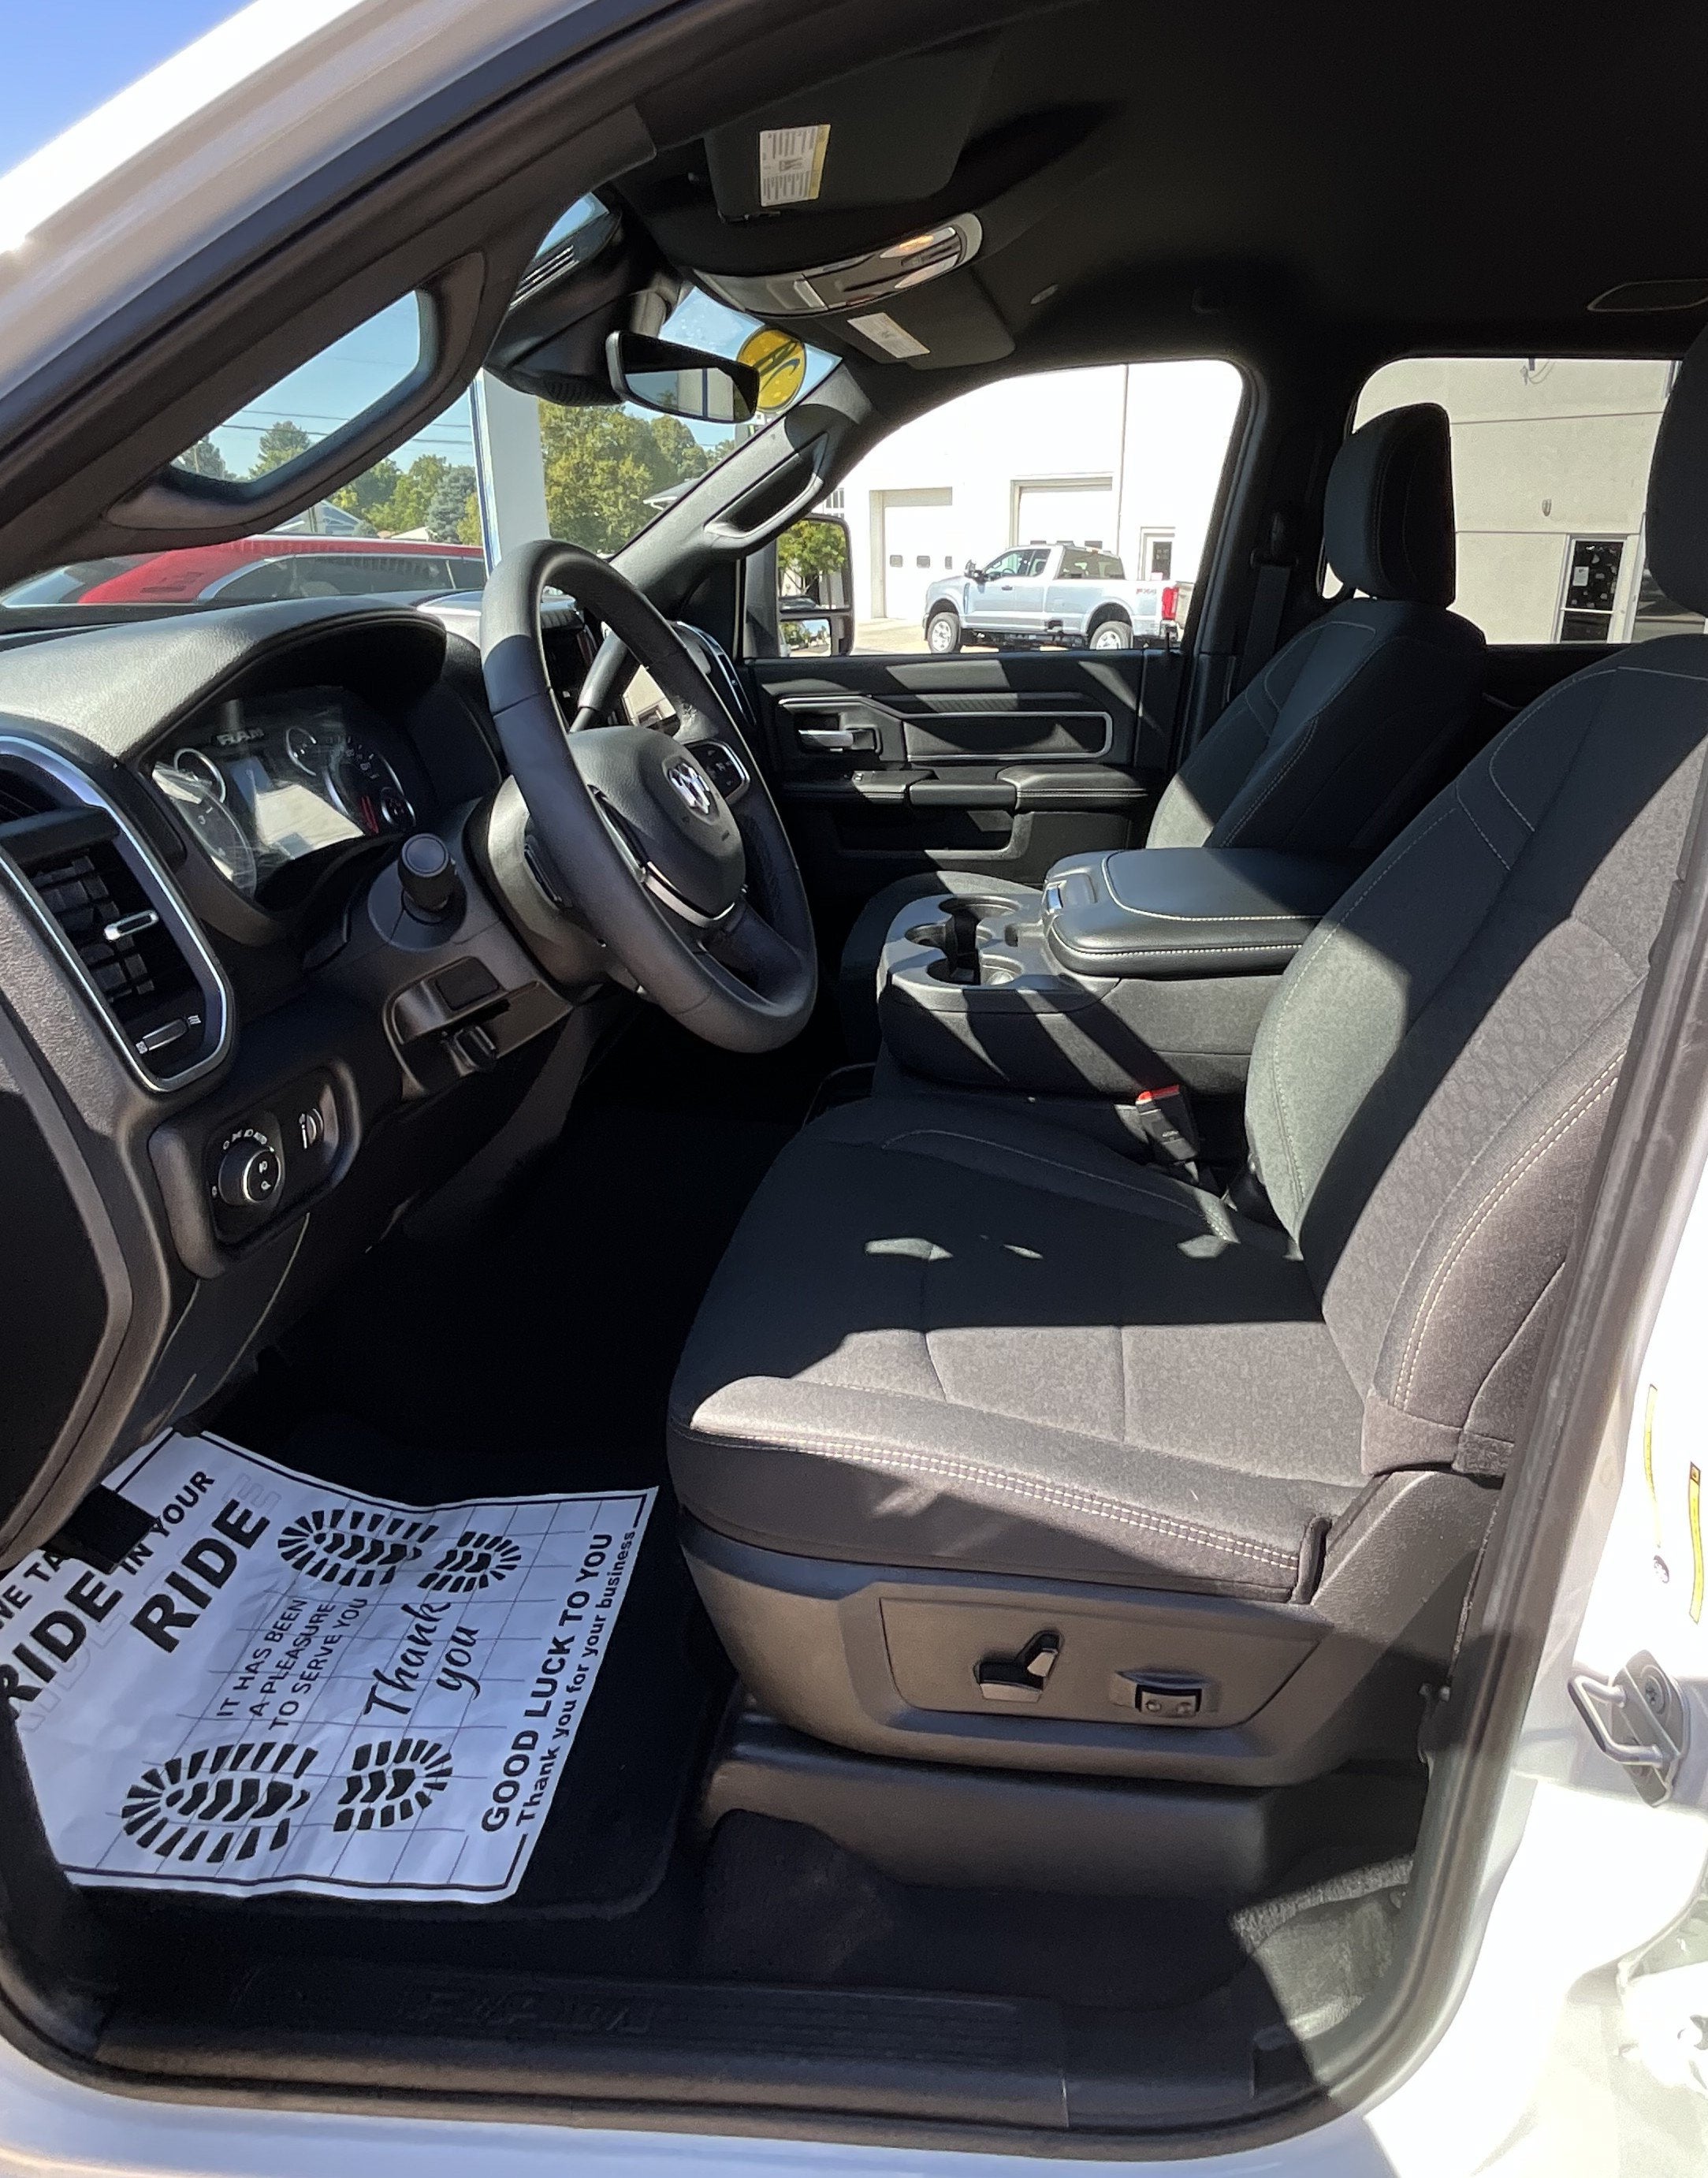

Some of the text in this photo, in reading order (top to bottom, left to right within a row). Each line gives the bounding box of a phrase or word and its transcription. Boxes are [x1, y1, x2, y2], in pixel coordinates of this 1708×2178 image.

[216, 728, 265, 746] RAM
[0, 1472, 215, 1720] RIDE IN YOUR
[130, 1499, 270, 1653] RIDE
[217, 1599, 307, 1717] IT HAS BEEN
[249, 1603, 337, 1717] A PLEASURE
[269, 1598, 368, 1730] TO SERVE YOU
[363, 1601, 452, 1715] Thank
[436, 1625, 480, 1700] you
[481, 1534, 612, 1832] GOOD LUCK TO YOU
[515, 1531, 635, 1826] Thank you for your business
